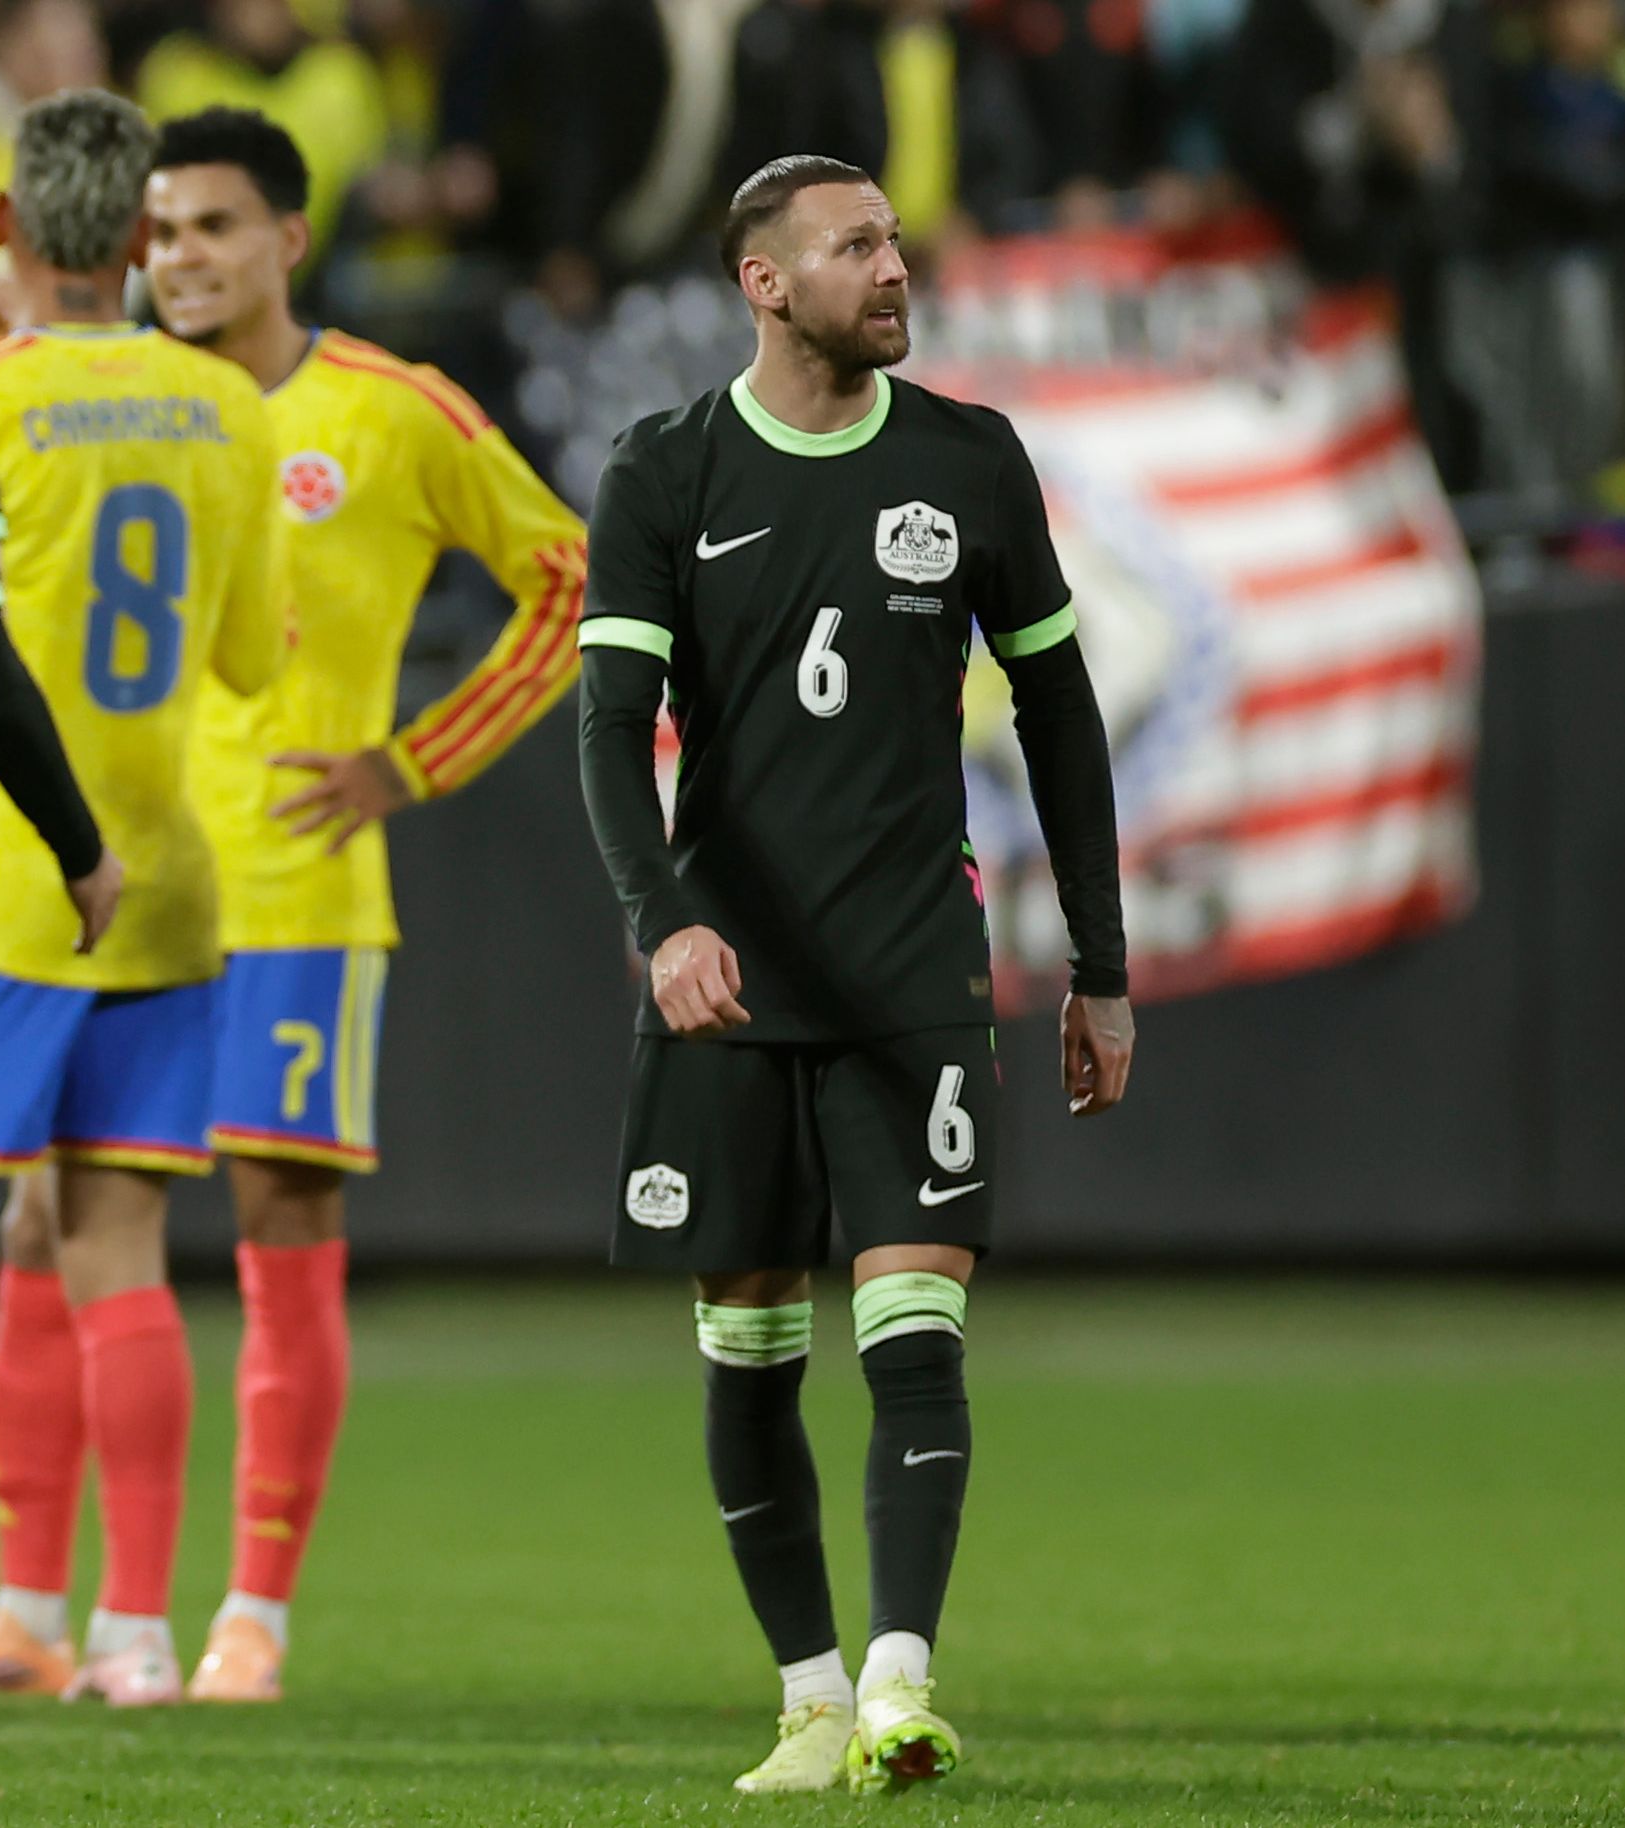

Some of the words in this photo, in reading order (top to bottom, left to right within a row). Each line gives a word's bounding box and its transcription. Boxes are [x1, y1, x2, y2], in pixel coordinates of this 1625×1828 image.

[83, 481, 189, 715] 8
[889, 551, 945, 563] AUSTRALIA
[797, 606, 849, 718] 6
[271, 1019, 325, 1121] 7
[927, 1064, 976, 1173] 6
